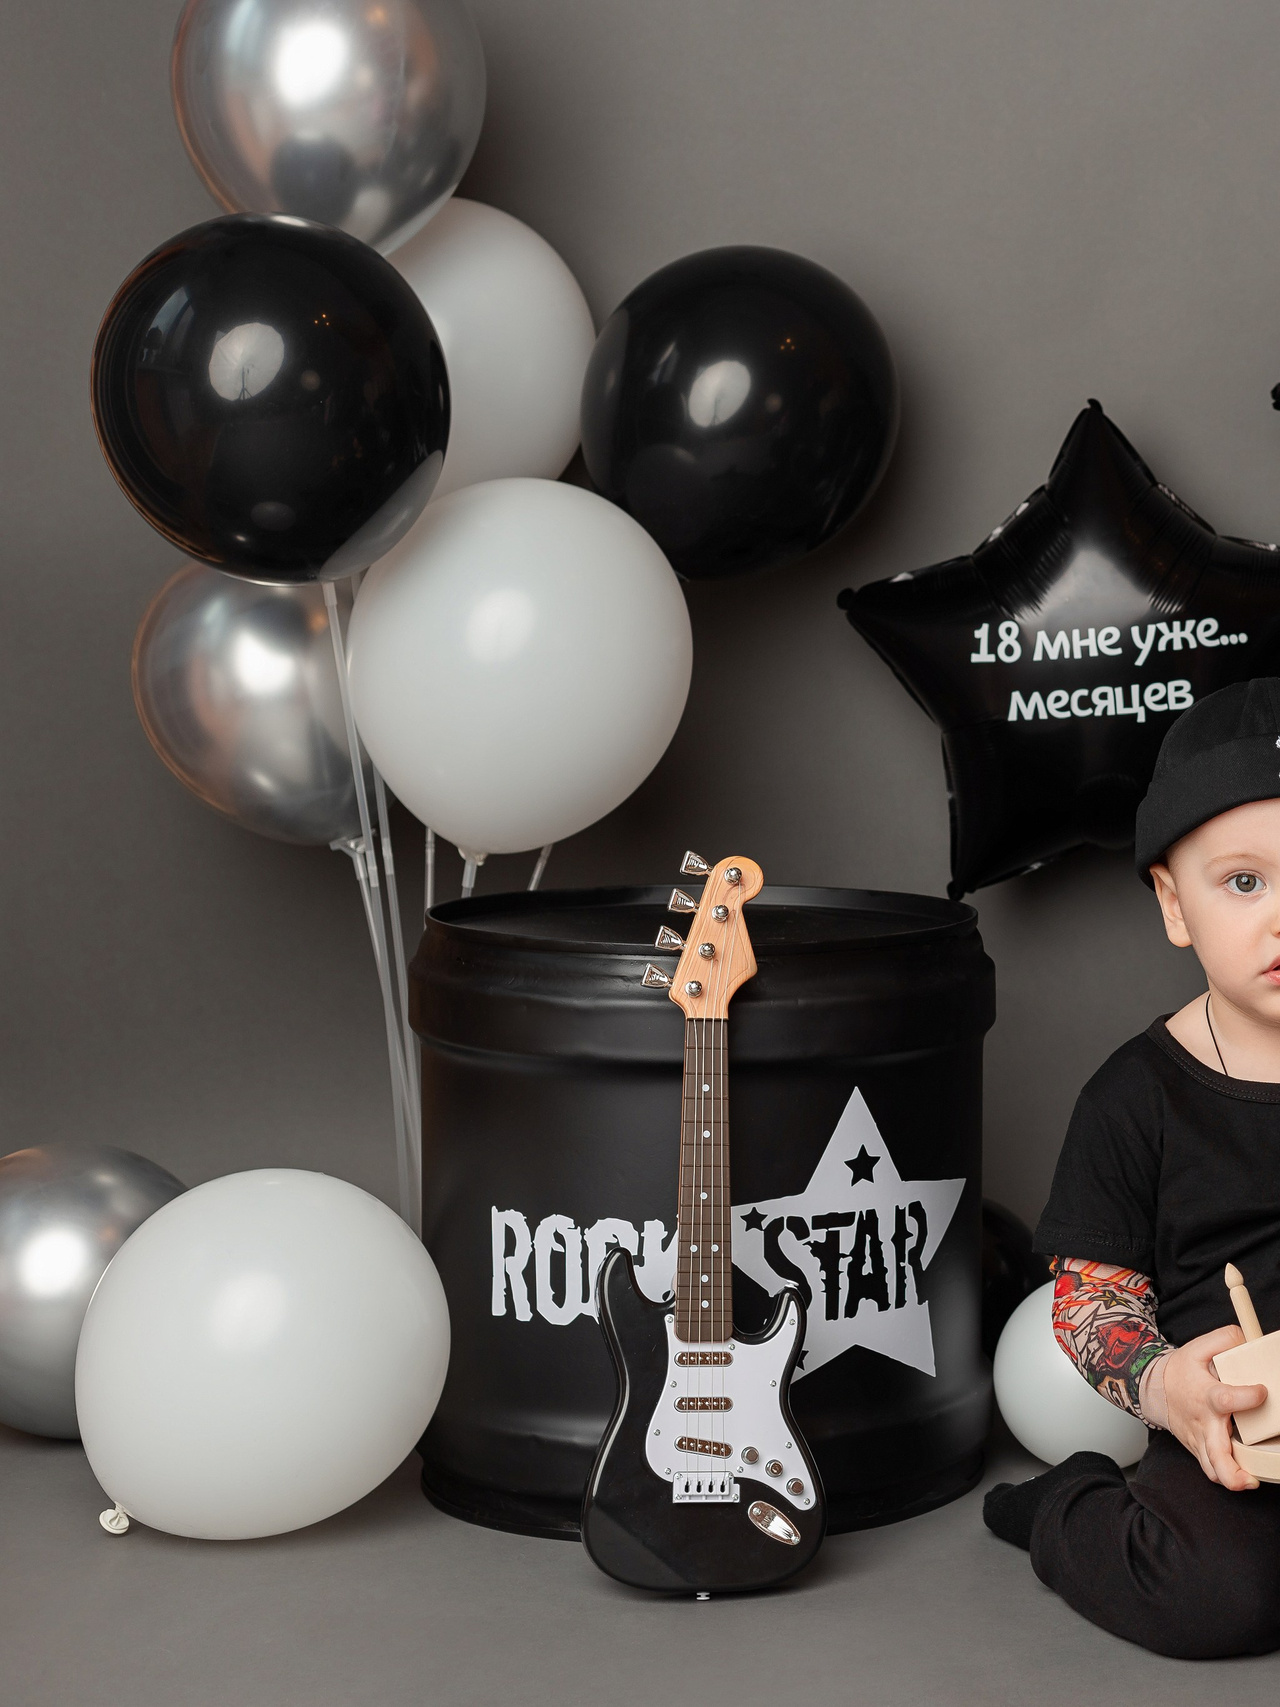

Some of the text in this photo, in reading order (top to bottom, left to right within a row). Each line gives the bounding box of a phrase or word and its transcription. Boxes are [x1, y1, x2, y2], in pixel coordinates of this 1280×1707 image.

[970, 617, 1248, 666] 18 мне уже...
[1007, 678, 1195, 723] месяцев
[763, 1200, 930, 1321] STAR
